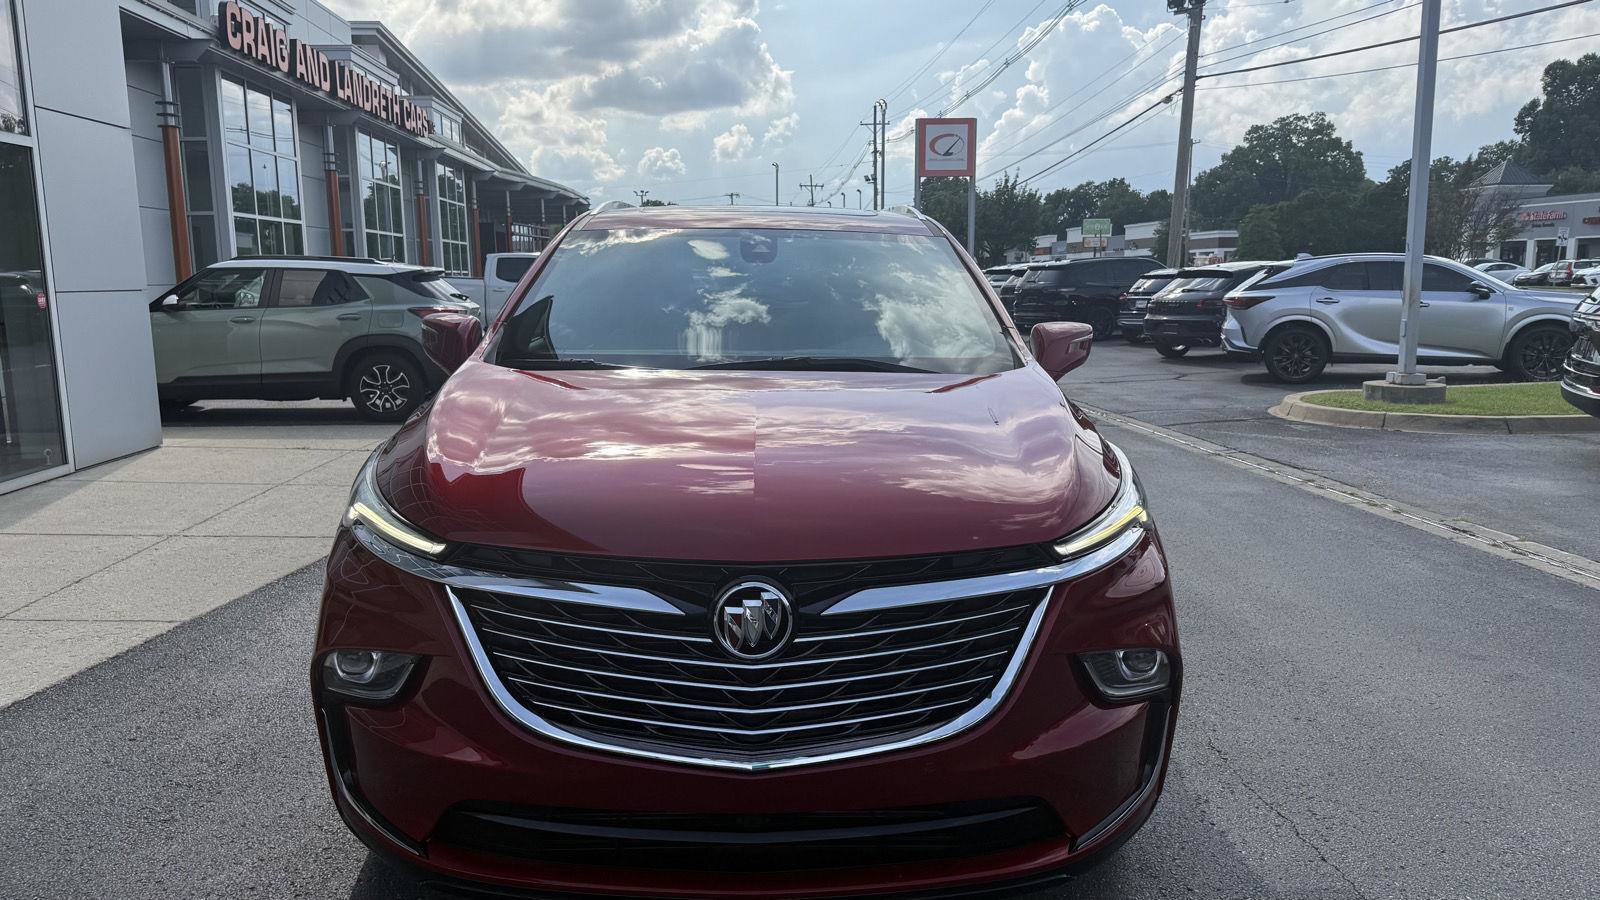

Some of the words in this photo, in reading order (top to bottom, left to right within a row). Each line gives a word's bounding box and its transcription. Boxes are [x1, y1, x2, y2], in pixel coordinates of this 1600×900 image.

[226, 0, 290, 73] CRAIG
[296, 42, 331, 92] AND
[335, 60, 401, 126] LANDRETH
[403, 99, 429, 138] CARS
